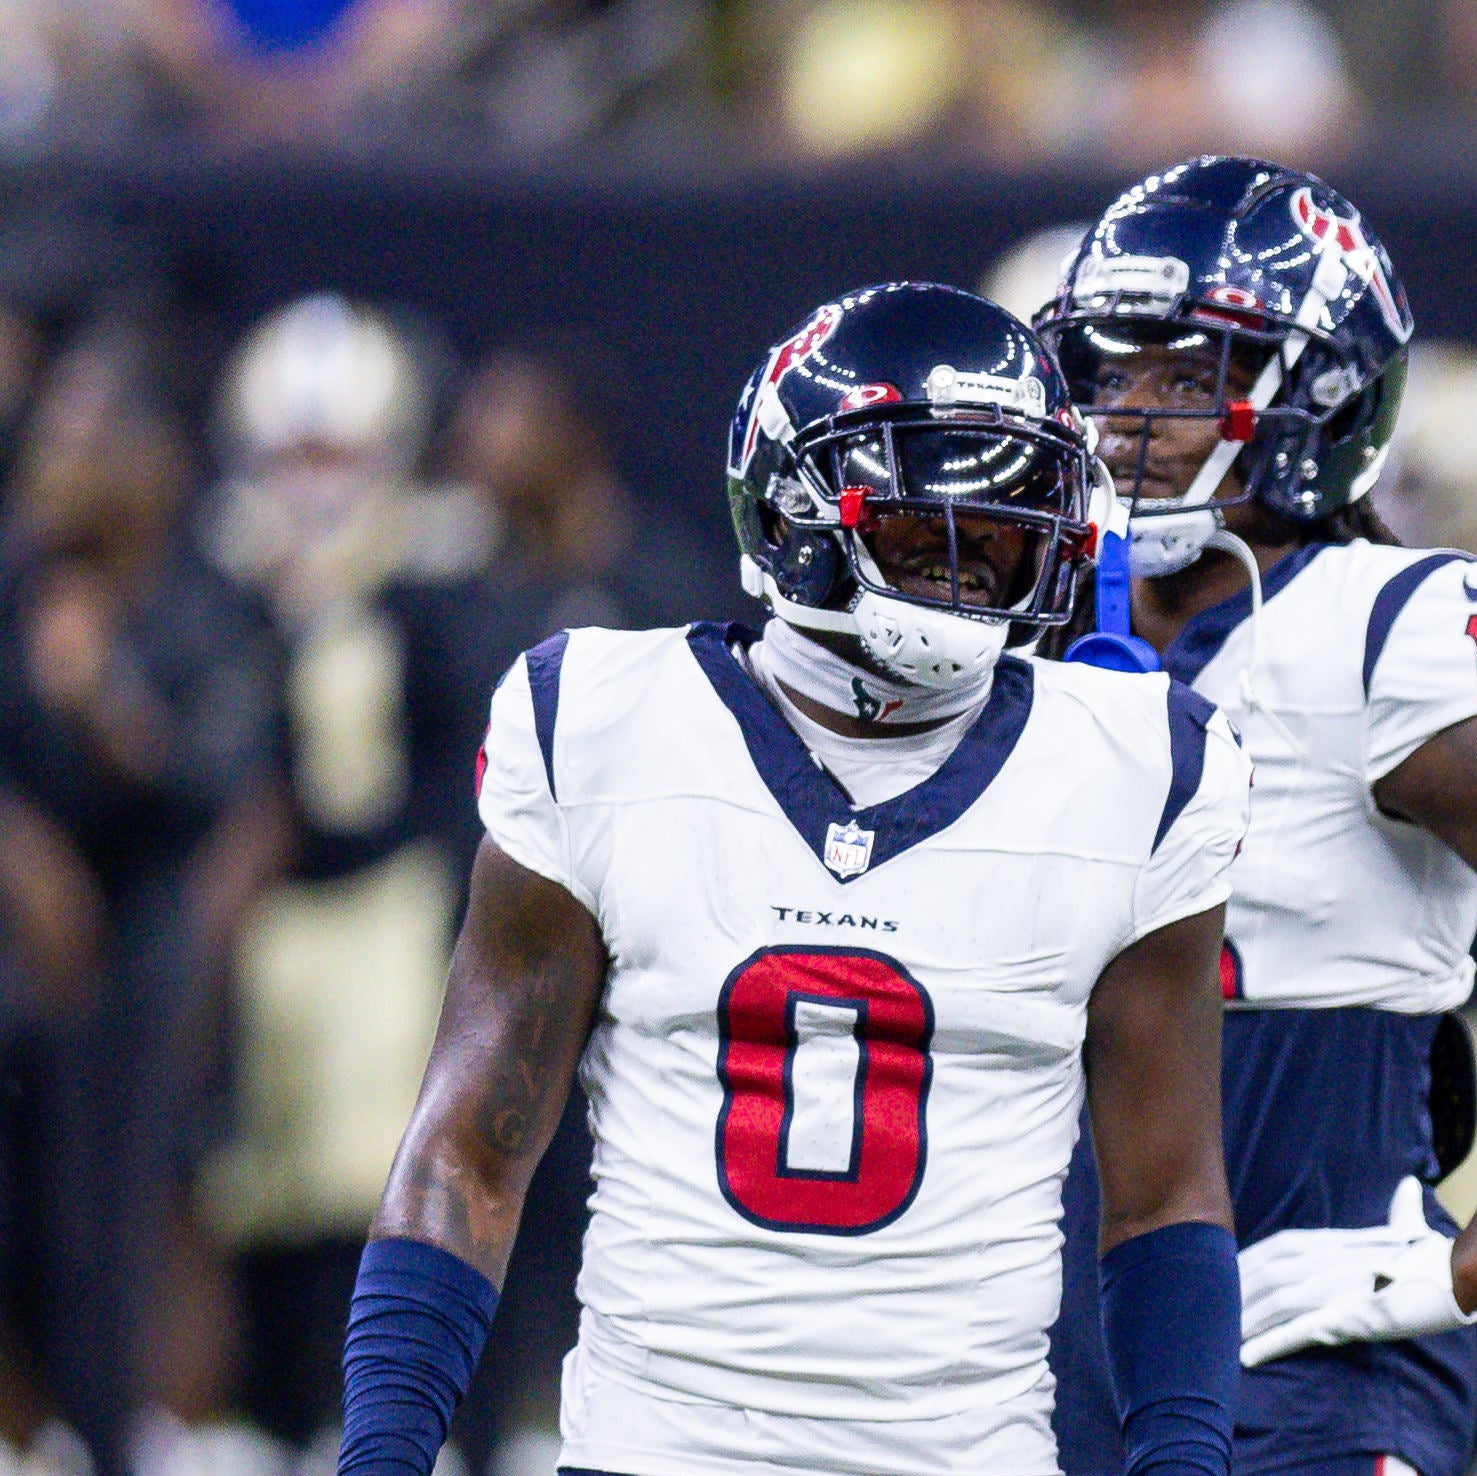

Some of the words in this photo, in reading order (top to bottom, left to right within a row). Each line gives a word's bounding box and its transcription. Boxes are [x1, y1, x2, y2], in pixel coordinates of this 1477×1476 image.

[833, 846, 861, 866] NFL
[770, 905, 899, 932] TEXANS
[714, 944, 937, 1238] 0
